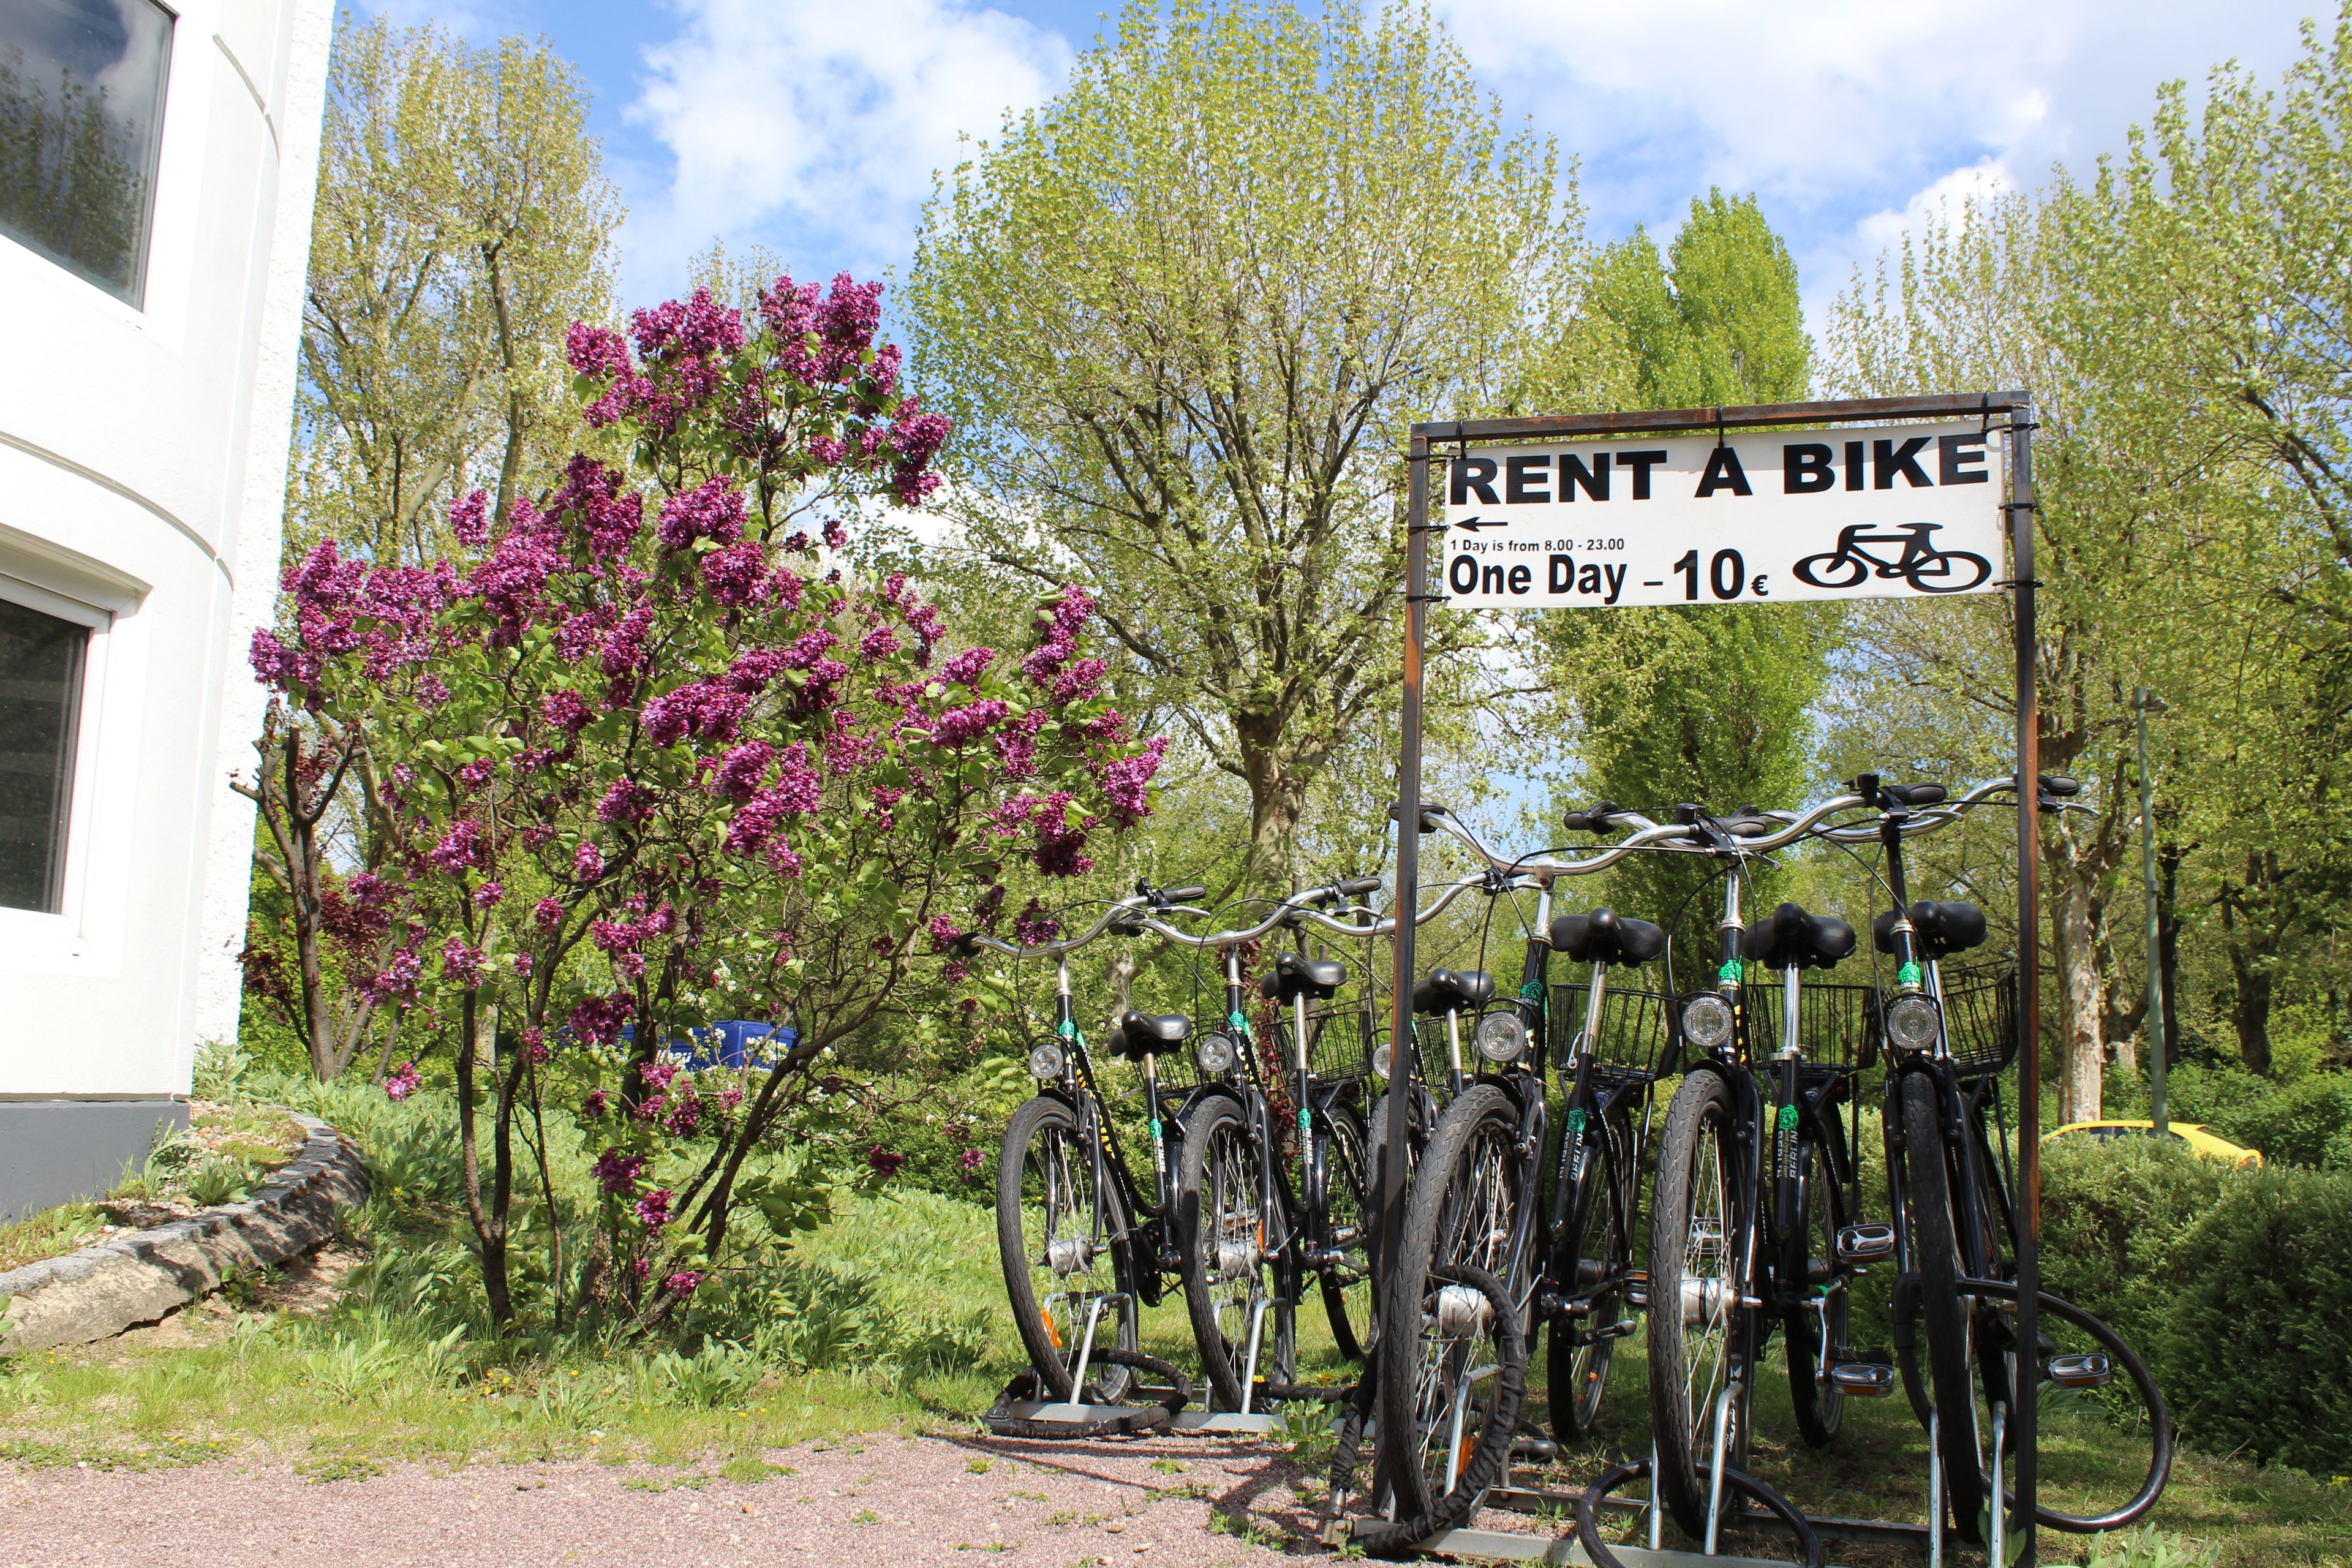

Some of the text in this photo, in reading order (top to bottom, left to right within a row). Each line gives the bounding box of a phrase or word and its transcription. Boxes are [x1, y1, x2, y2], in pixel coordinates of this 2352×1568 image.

[1450, 432, 1988, 505] RENT A BIKE
[1450, 540, 1457, 550] 1
[1463, 540, 1488, 554] Day
[1493, 540, 1504, 551] is
[1509, 540, 1539, 551] from
[1545, 539, 1573, 551] 8.00
[1586, 538, 1624, 550] 23.00
[1449, 554, 1531, 594] One
[1548, 554, 1627, 605] Day
[1157, 1137, 1166, 1172] BERLIN
[1570, 1133, 1583, 1181] BERLIN
